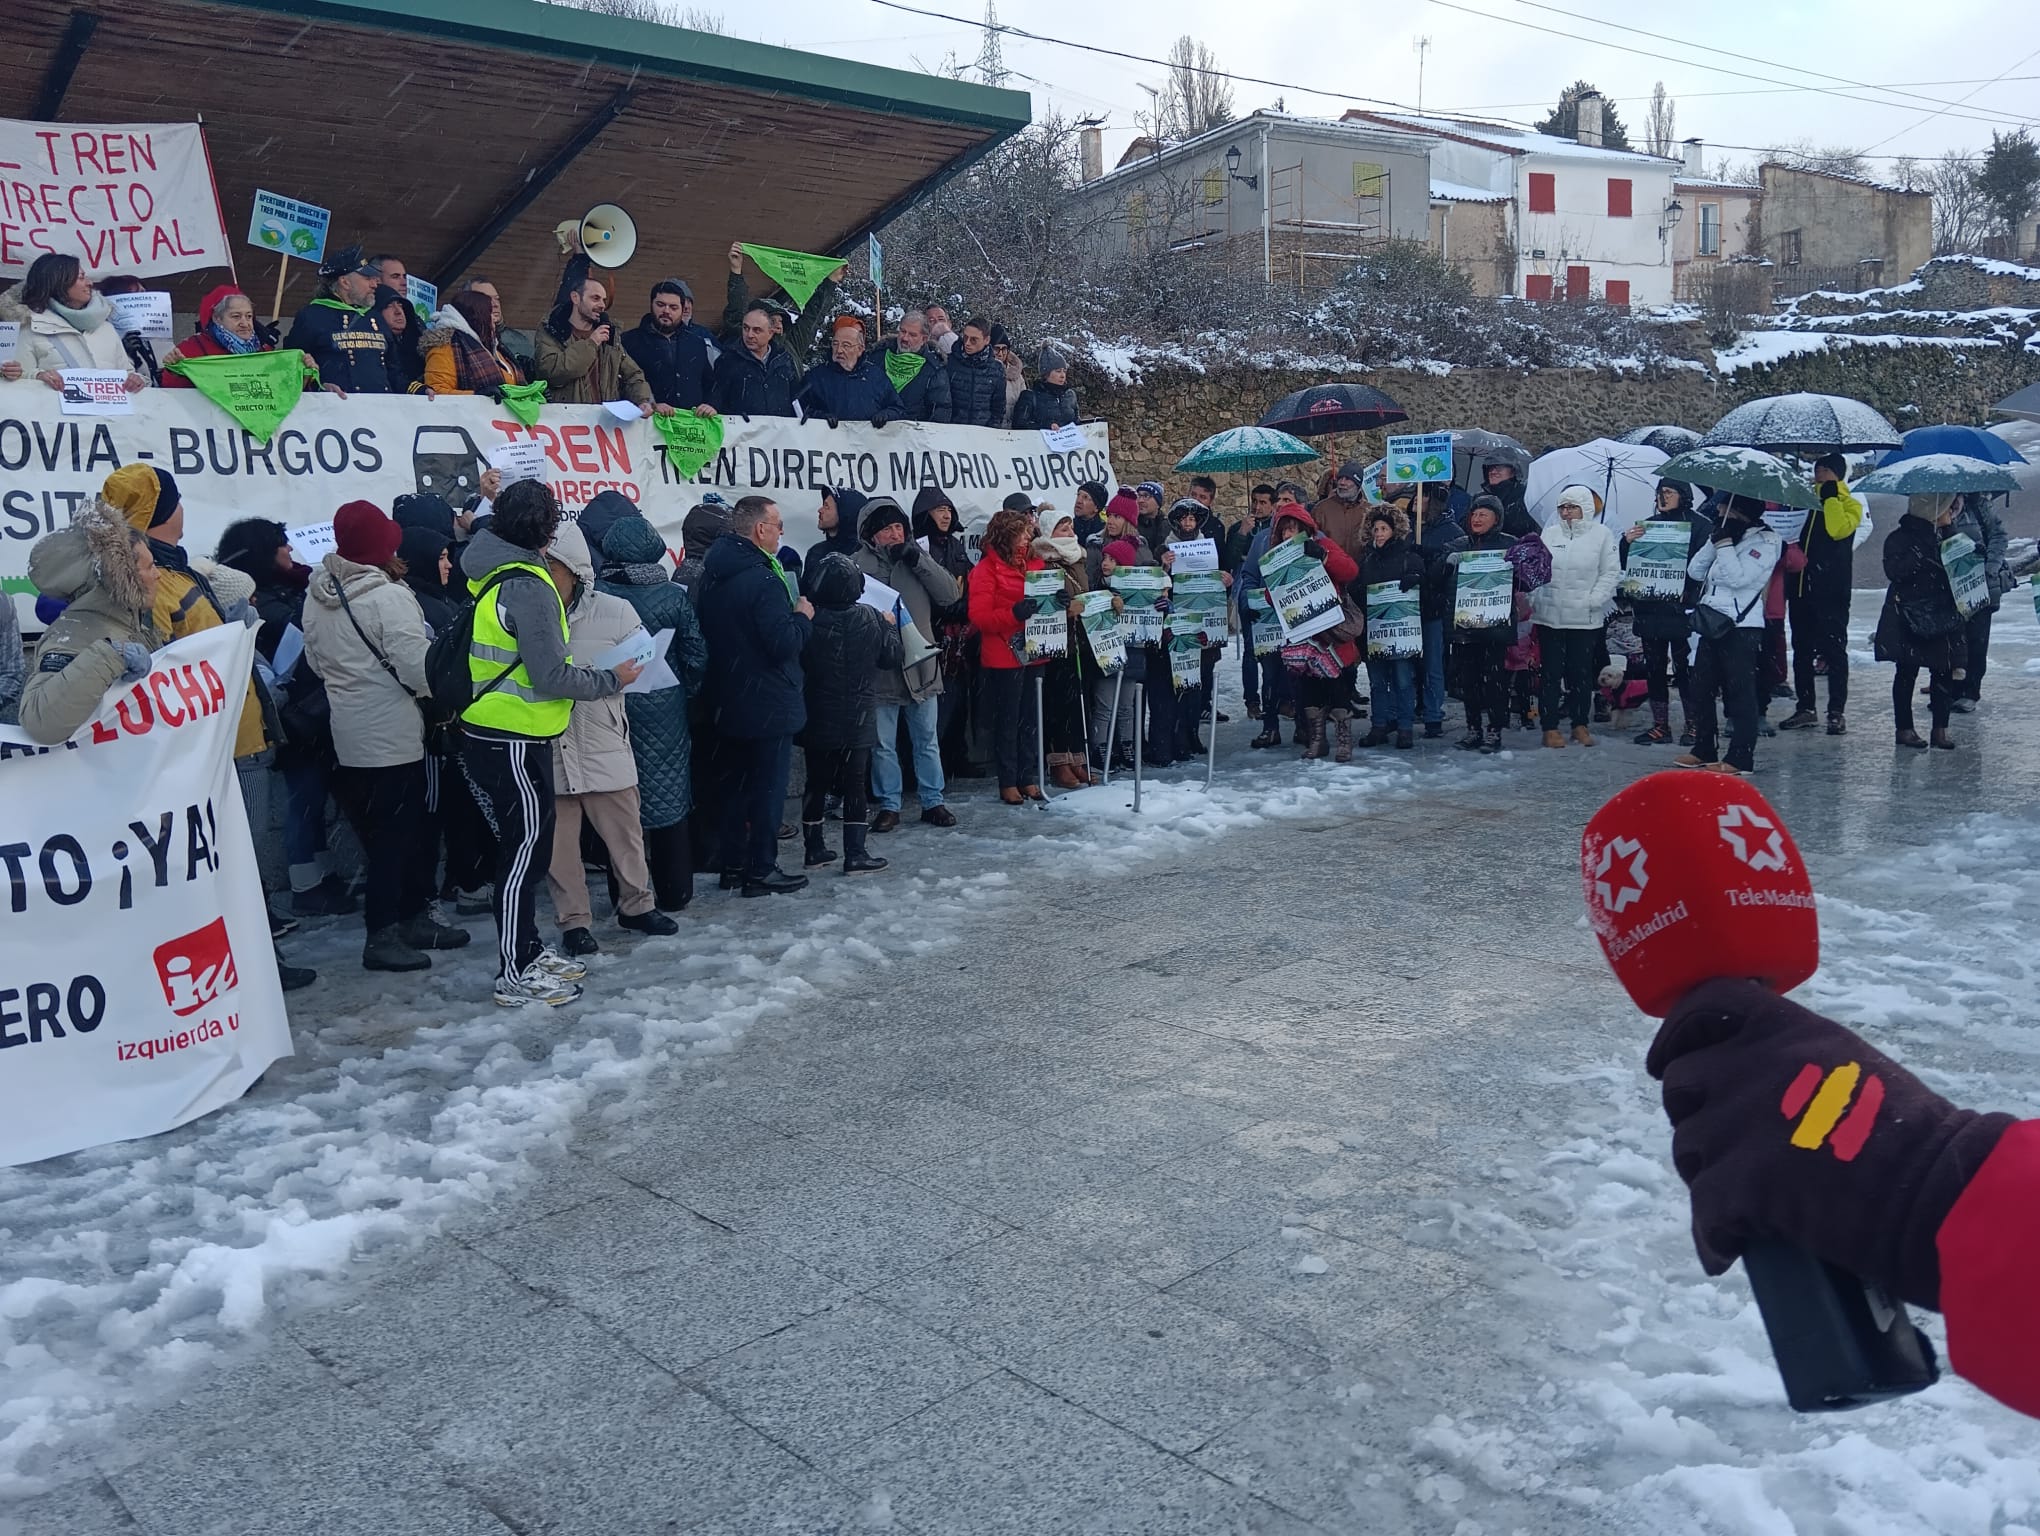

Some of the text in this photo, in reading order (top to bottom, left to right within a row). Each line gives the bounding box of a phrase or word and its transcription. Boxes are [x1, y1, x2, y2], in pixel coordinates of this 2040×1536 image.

[35, 131, 157, 176] TREN
[1, 218, 205, 268] ES VITAL
[84, 382, 126, 395] TREN
[235, 404, 264, 412] DIRECTO
[169, 427, 383, 476] BURGOS
[493, 419, 632, 475] TREN
[670, 444, 695, 453] DIRECTO
[749, 446, 879, 493] DIRECTO
[889, 450, 999, 492] MADRID
[1012, 449, 1109, 492] BURGOS
[2, 489, 103, 541] SIT
[560, 510, 582, 522] DRI
[1627, 568, 1685, 580] APOYO AL DIRECTO
[1278, 575, 1331, 609] APOYO AL DIRECTO
[1457, 595, 1511, 608] APOYO AL DIRECTO
[1116, 615, 1130, 625] OYO
[1129, 615, 1138, 625] AL
[1139, 615, 1163, 625] DIRECTO
[1204, 617, 1228, 628] DIRECTO
[1026, 623, 1067, 637] APOYO AL DIRECTO
[1255, 632, 1283, 644] APOYO AL
[1369, 626, 1421, 640] APOYO AL DIRECTO
[1094, 641, 1112, 655] APOYO
[1111, 639, 1118, 649] AL
[91, 660, 226, 745] LUCHA
[112, 797, 219, 910] ¡YA!
[1724, 888, 1815, 910] TeleMadrid
[0, 974, 106, 1049] ERO
[117, 1018, 224, 1061] izquierda
